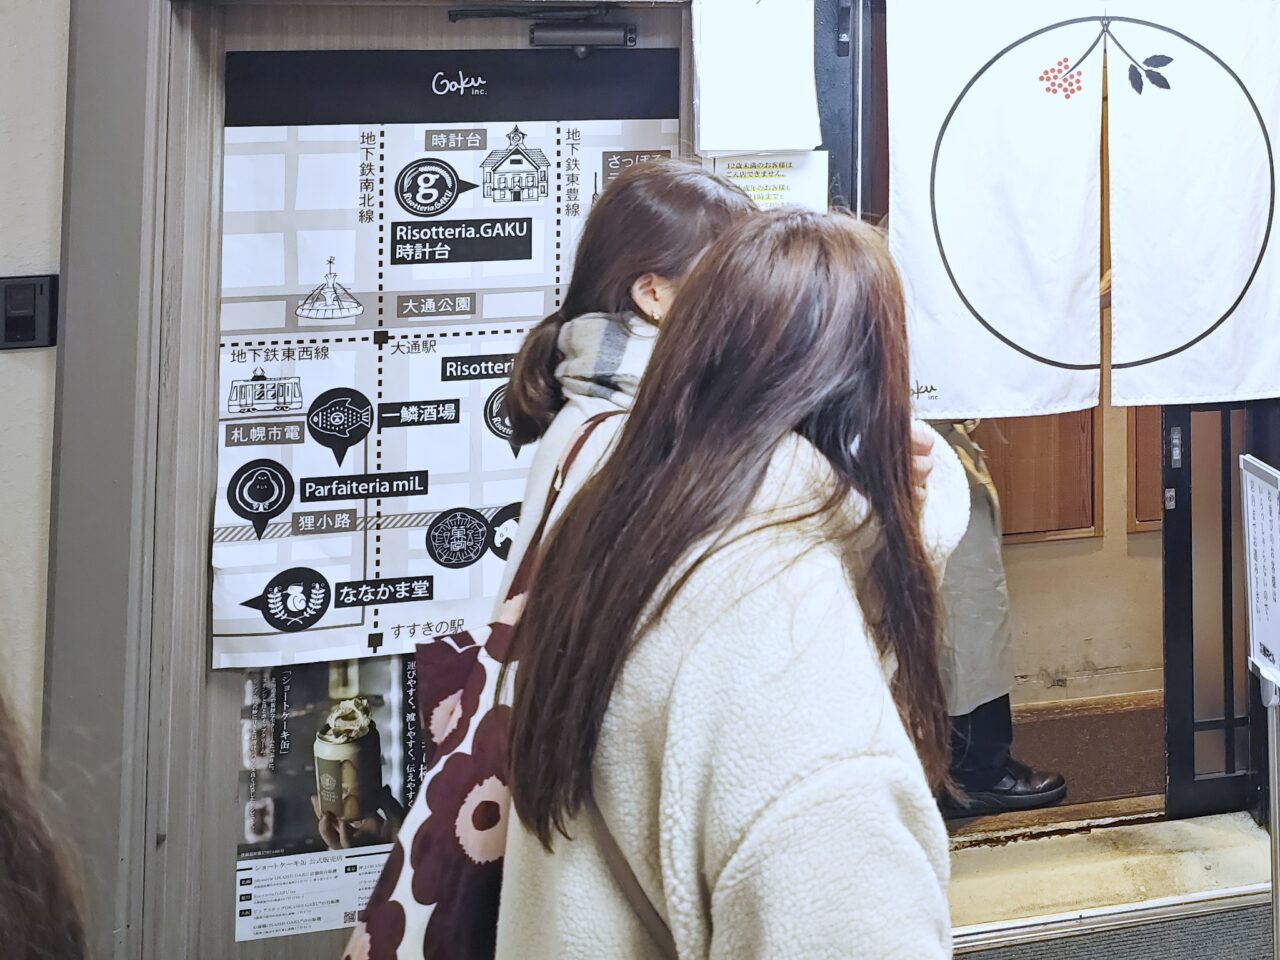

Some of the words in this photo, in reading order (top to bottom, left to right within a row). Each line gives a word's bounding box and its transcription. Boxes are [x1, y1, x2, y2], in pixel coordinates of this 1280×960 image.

[432, 70, 488, 96] Gaku
[471, 88, 488, 96] inc.
[431, 132, 482, 149] 時計台
[359, 131, 375, 224] 地下鉄南北線
[565, 127, 581, 217] 地下鉄東豊線
[396, 221, 528, 240] Risotteria.GAKU
[395, 243, 450, 260] 時計台
[402, 296, 471, 314] 大通公園
[230, 346, 330, 363] 地下鉄東西線
[390, 340, 437, 356] 大通駅
[446, 358, 515, 377] Risotteri
[382, 403, 457, 423] 一鱗酒場
[231, 425, 301, 443] 札幌市電
[305, 481, 390, 497] Parfaiteria
[392, 476, 424, 493] miL
[298, 514, 352, 531] 狸小路
[339, 580, 430, 603] ななかま堂
[391, 619, 465, 639] すすきの駅
[280, 670, 292, 754] 「ショートケーキ缶」
